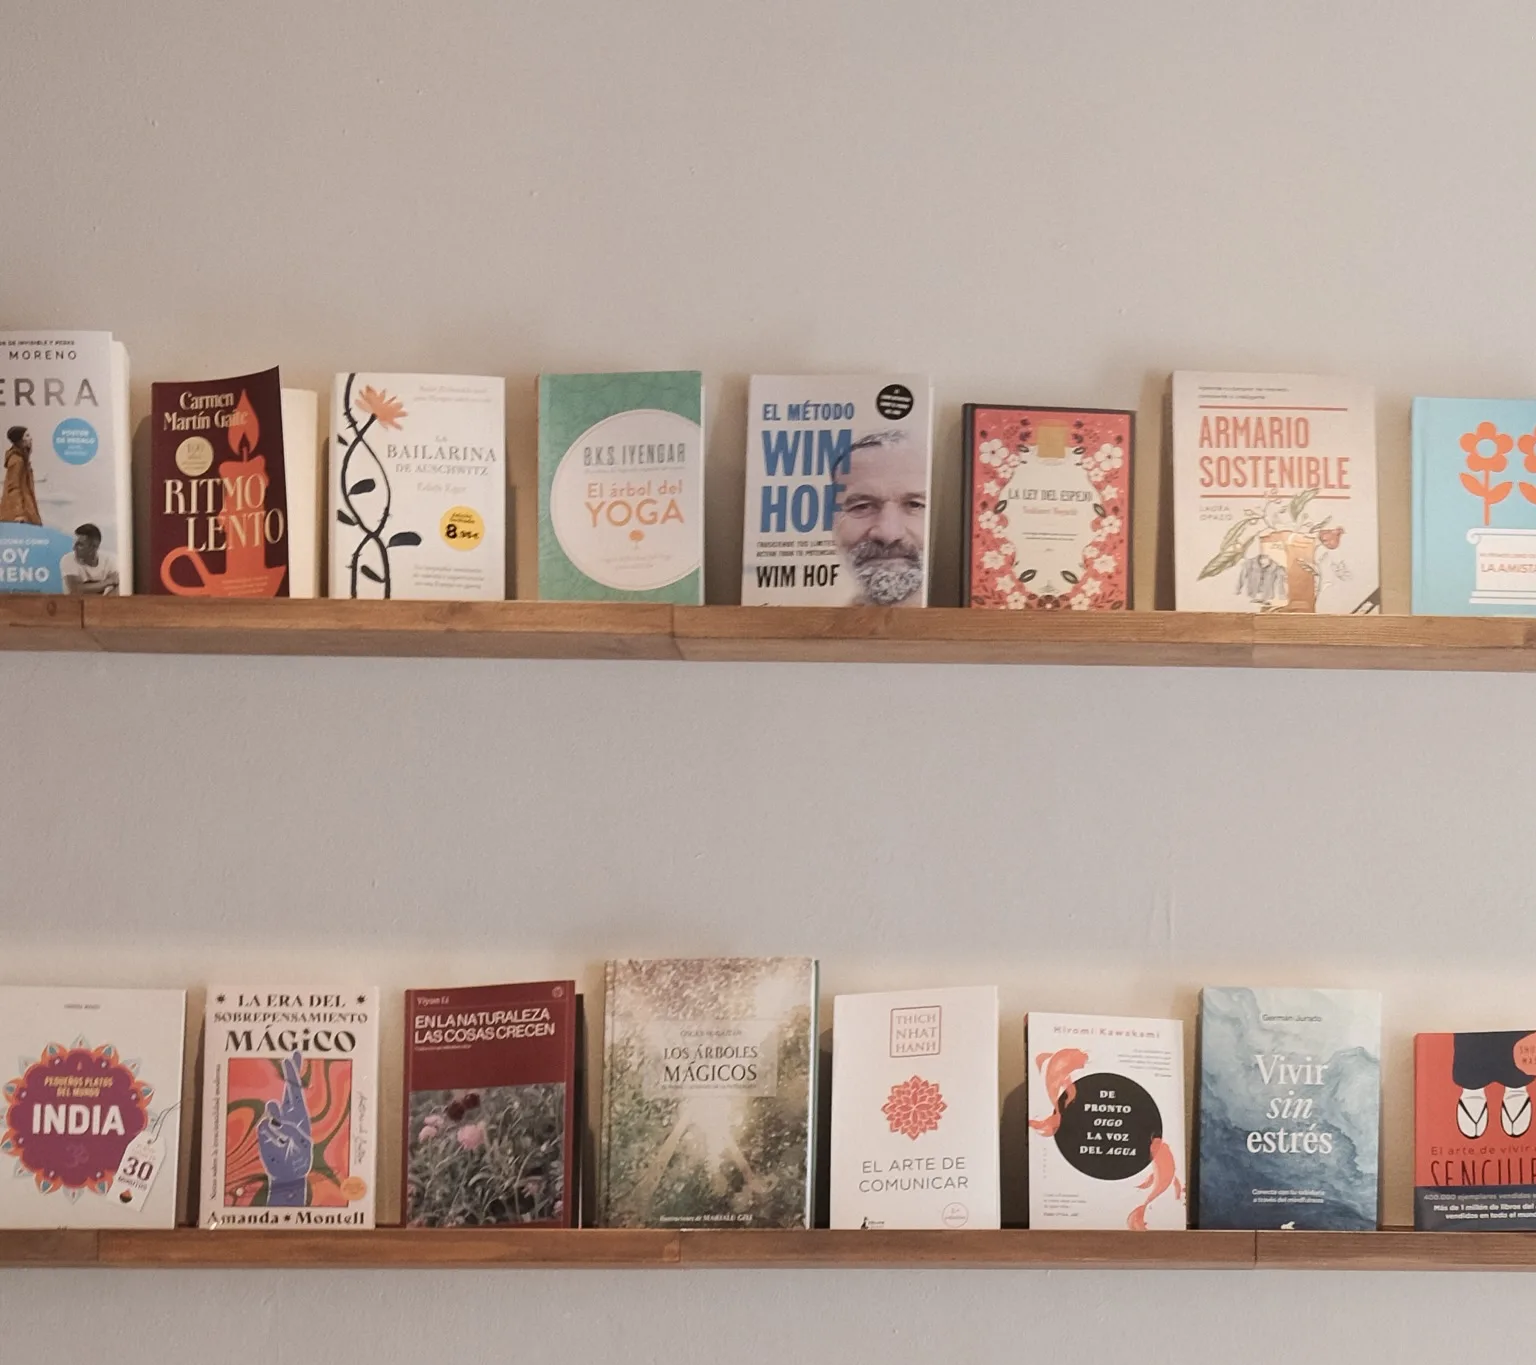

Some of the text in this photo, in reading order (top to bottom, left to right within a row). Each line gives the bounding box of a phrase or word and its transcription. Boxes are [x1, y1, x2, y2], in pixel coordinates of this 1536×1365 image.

[9, 350, 77, 360] MORENO
[179, 391, 235, 411] Carmen
[163, 408, 249, 431] Martín Gaite
[1199, 415, 1310, 448] ARMARIO
[386, 444, 498, 463] BAILARINA
[621, 443, 686, 465] IYENGAR
[761, 429, 853, 477] WIM
[1199, 455, 1351, 489] SOSTENIBLE
[163, 473, 267, 516] RITMO
[585, 498, 686, 528] YOGA
[185, 507, 286, 553] LENTO
[756, 564, 841, 588] WIM HOF
[213, 1011, 369, 1024] SOBREPENSAMIENTO
[414, 1022, 556, 1044] LAS COSAS CRECEN
[1053, 1025, 1161, 1039] Hiromi Kawakami
[663, 1060, 758, 1082] MÁGICOS
[1254, 1054, 1329, 1086] Vivir
[1084, 1104, 1132, 1114] PRONTO
[1266, 1090, 1313, 1120] sin
[32, 1103, 126, 1136] INDIA
[1246, 1123, 1333, 1154] estrés
[1431, 1146, 1443, 1155] El
[1447, 1146, 1474, 1155] arte
[1480, 1145, 1495, 1155] de
[1501, 1145, 1529, 1154] vivir
[122, 1156, 154, 1182] 30
[862, 1157, 966, 1174] EL ARTE DE
[858, 1176, 969, 1193] COMUNICAR
[207, 1211, 365, 1225] Amanda Montell
